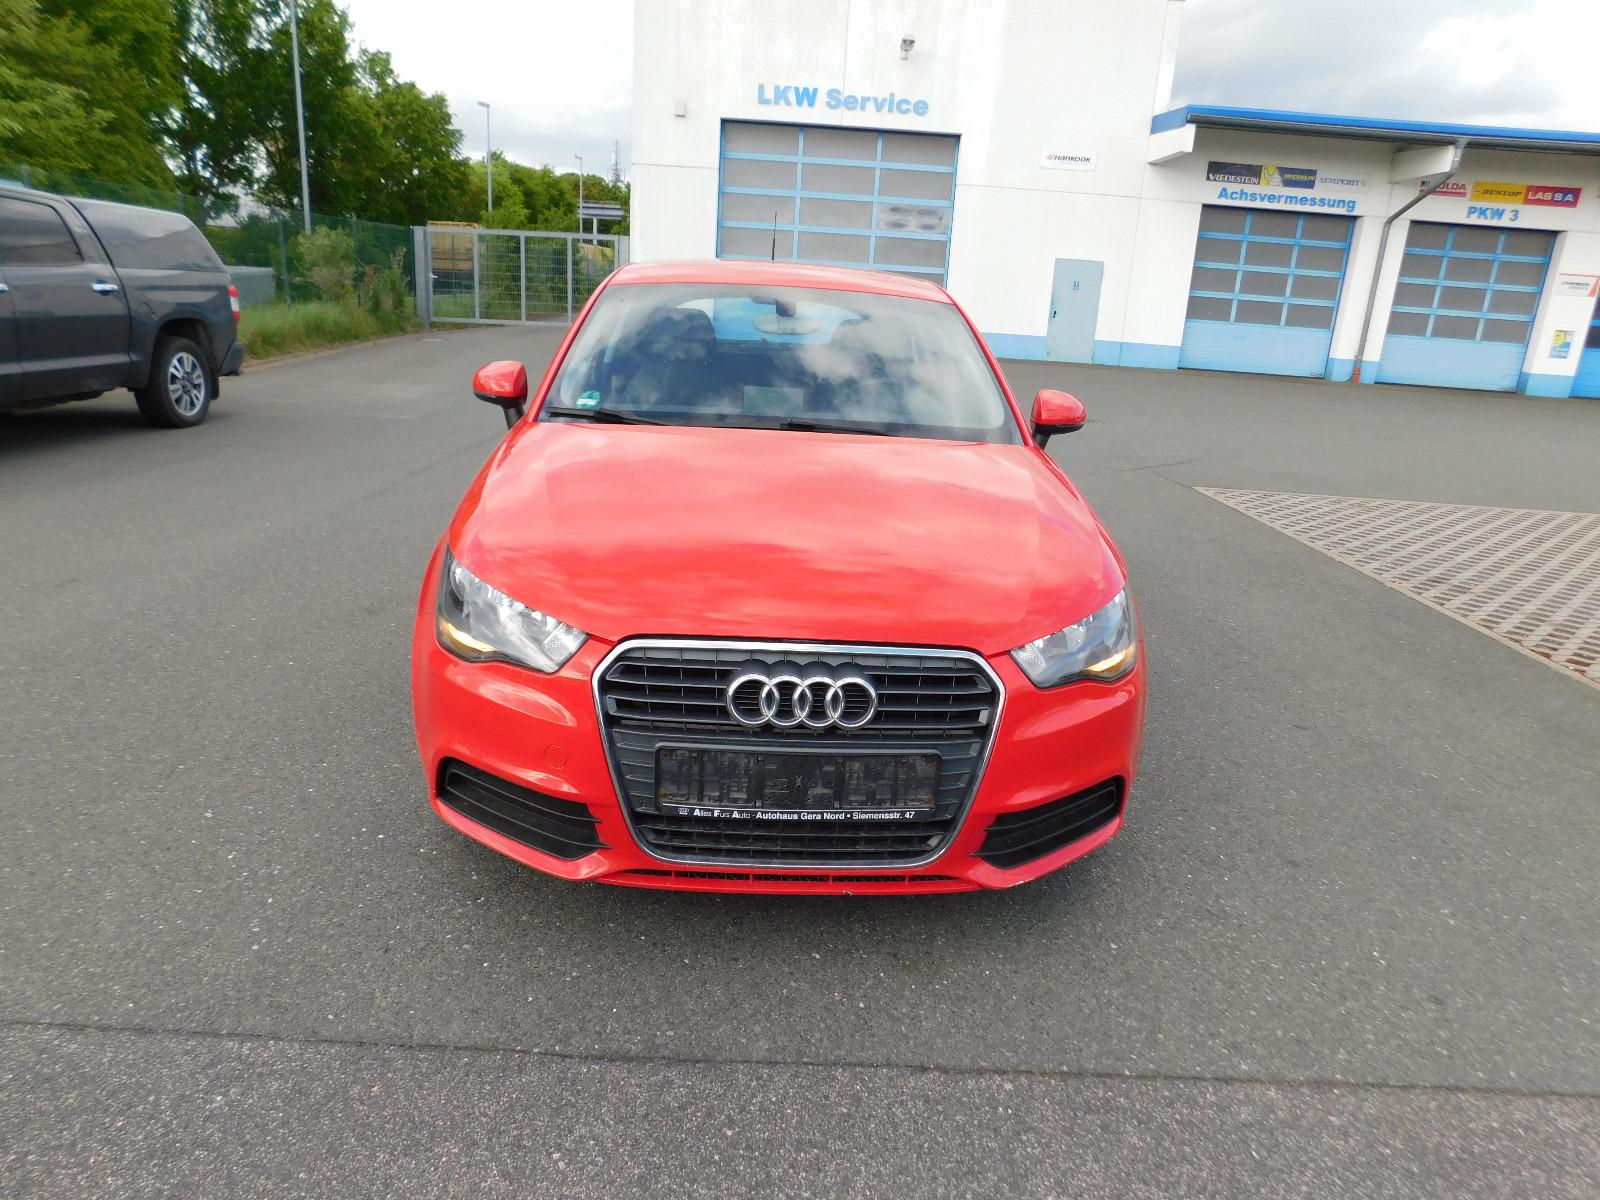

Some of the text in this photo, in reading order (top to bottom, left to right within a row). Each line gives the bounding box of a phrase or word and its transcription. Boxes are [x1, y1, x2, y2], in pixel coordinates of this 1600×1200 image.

[757, 84, 929, 116] LKW Service
[1209, 173, 1260, 184] VREDESTEIN
[1217, 187, 1356, 212] Achsvermessung
[1466, 206, 1520, 222] PKW 3
[756, 811, 798, 820] Autohaus
[800, 812, 821, 820] Gera
[823, 812, 845, 820] Nord
[852, 811, 903, 820] Siemensstr.
[905, 811, 915, 819] 47
